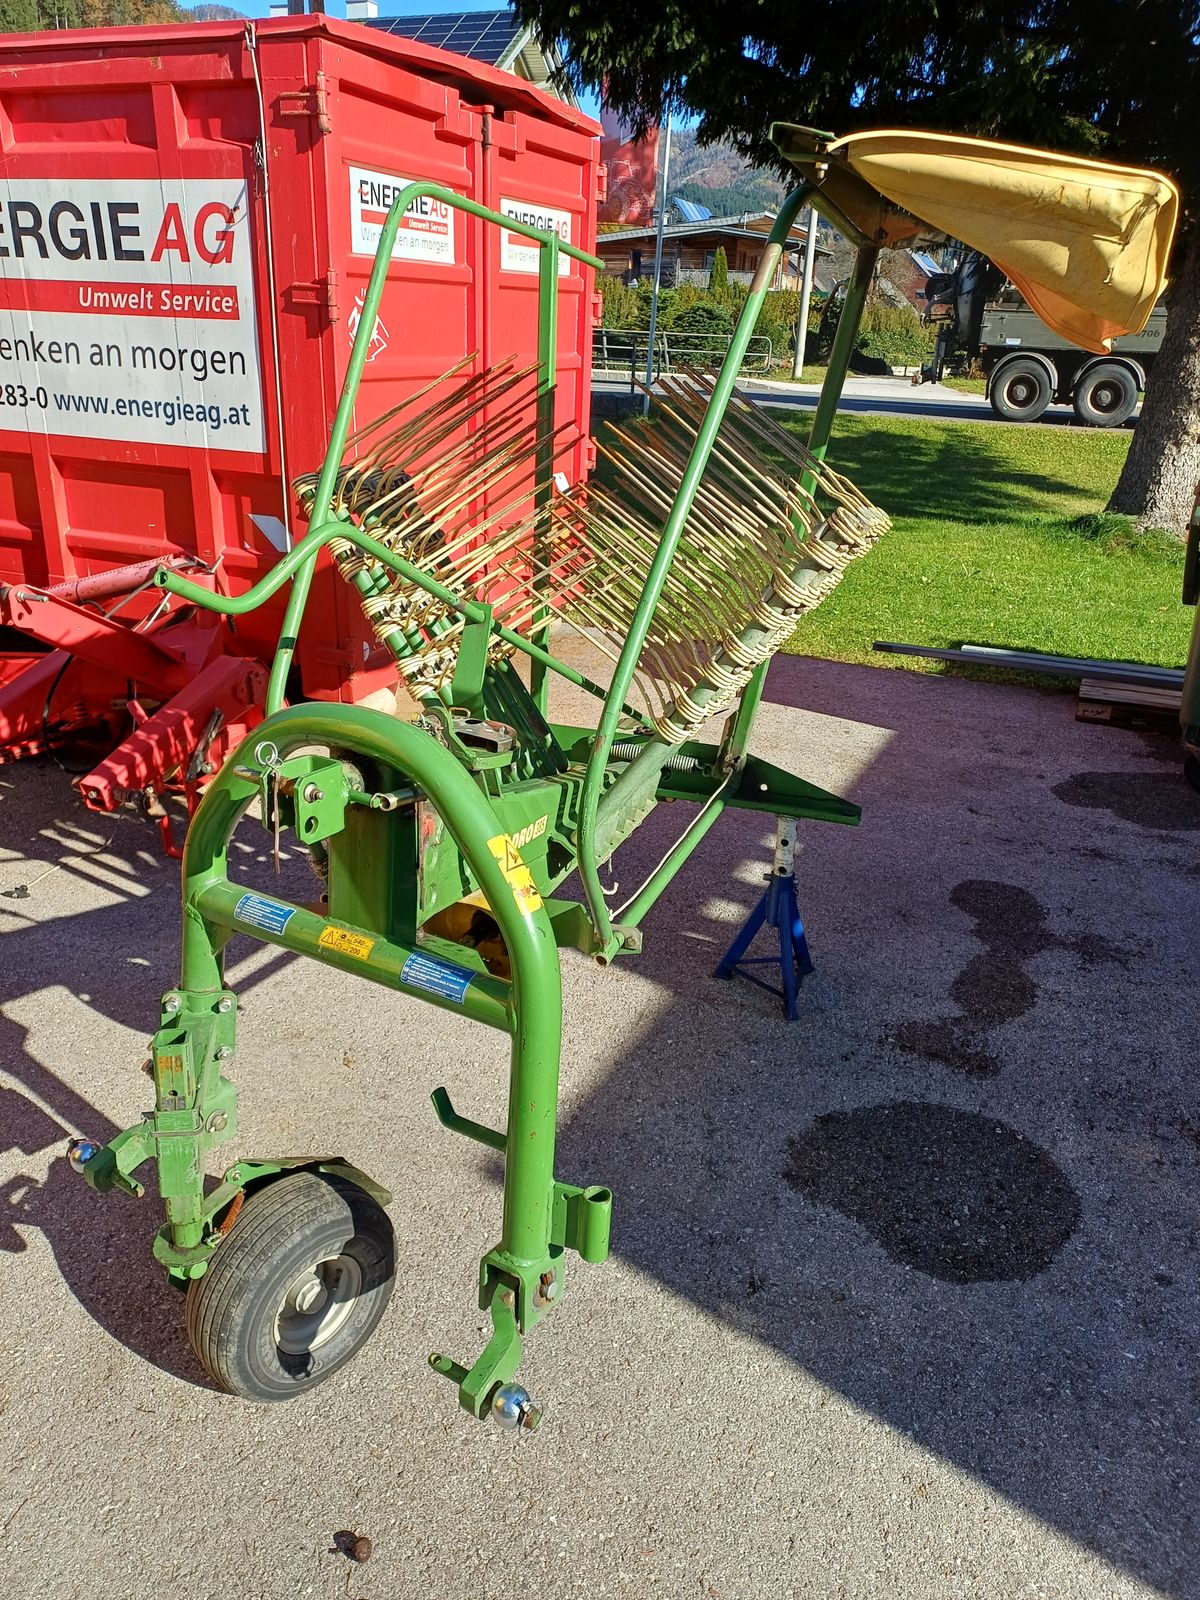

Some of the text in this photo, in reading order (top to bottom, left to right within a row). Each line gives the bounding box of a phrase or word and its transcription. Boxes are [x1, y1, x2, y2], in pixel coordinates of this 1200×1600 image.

[78, 286, 234, 314] Umwelt Service
[89, 343, 122, 367] an
[131, 345, 247, 381] morgen
[53, 391, 251, 430] www.energieag.at
